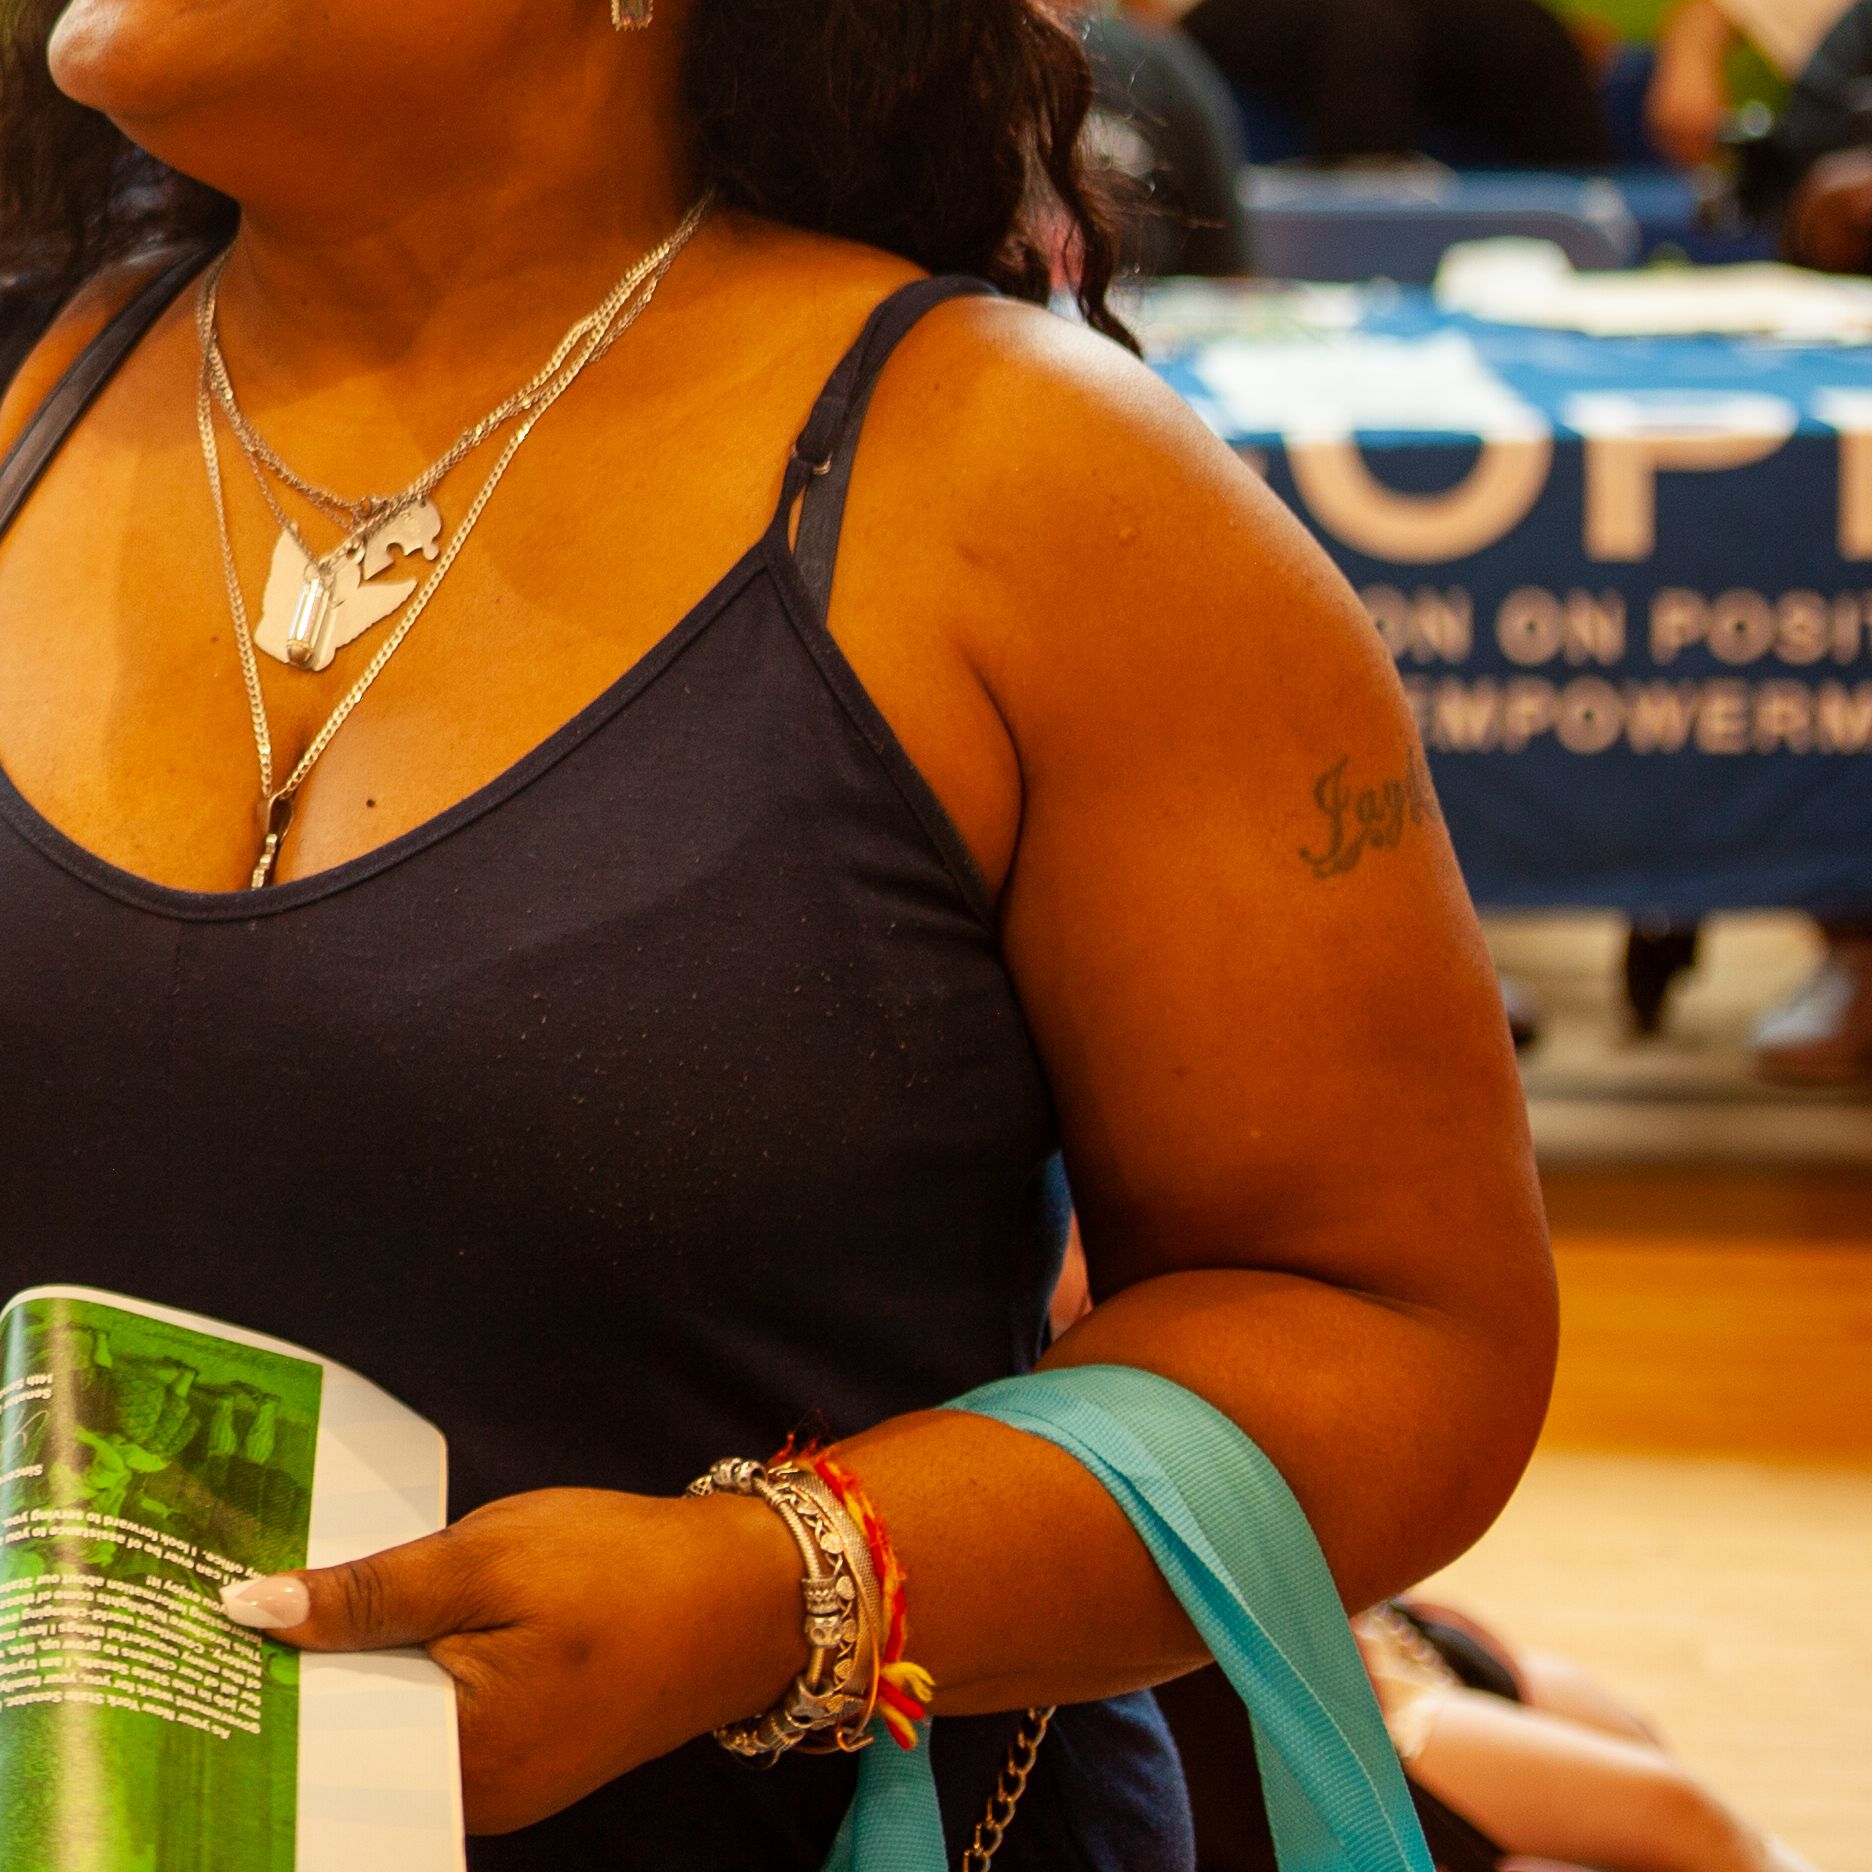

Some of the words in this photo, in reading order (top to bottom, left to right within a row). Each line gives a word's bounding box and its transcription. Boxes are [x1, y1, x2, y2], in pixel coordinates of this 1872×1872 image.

[1241, 386, 1872, 565] OP
[1494, 585, 1628, 667] ON
[1649, 587, 1872, 668] POSI
[30, 1509, 85, 1521] serving
[86, 1512, 102, 1524] to
[4, 1526, 32, 1544] you
[32, 1527, 47, 1539] to
[48, 1526, 126, 1544] assistance
[103, 1516, 159, 1542] forward
[126, 1537, 143, 1549] of
[144, 1543, 162, 1559] be
[160, 1533, 191, 1555] look
[192, 1546, 198, 1557] I
[163, 1551, 194, 1569] ever
[36, 1574, 61, 1585] our
[195, 1563, 222, 1580] can
[0, 1578, 33, 1594] State
[60, 1574, 105, 1588] about
[36, 1591, 52, 1605] of
[53, 1590, 94, 1602] some
[107, 1579, 188, 1616] information
[163, 1579, 201, 1603] enjoy
[21, 1604, 135, 1626] world-changing
[96, 1595, 167, 1625] highlights
[18, 1625, 48, 1637] love
[58, 1621, 105, 1638] things
[169, 1615, 231, 1650] brochure
[189, 1605, 262, 1648] interesting
[106, 1627, 180, 1657] wonderful
[137, 1618, 205, 1654] Countless
[62, 1639, 102, 1651] grow
[103, 1644, 119, 1657] to
[233, 1642, 261, 1663] This
[39, 1657, 64, 1668] am
[121, 1647, 177, 1670] citizens
[182, 1651, 220, 1674] many
[43, 1671, 77, 1684] your
[131, 1666, 170, 1687] State
[178, 1665, 203, 1681] our
[221, 1668, 244, 1685] the
[113, 1679, 136, 1694] for
[172, 1678, 196, 1695] the
[204, 1676, 219, 1688] of
[220, 1682, 240, 1696] all
[246, 1678, 261, 1690] of
[64, 1692, 105, 1705] State
[136, 1684, 174, 1702] work
[198, 1688, 213, 1703] in
[240, 1691, 261, 1706] for
[107, 1694, 140, 1712] York
[141, 1702, 176, 1721] New
[212, 1694, 237, 1712] job
[237, 1703, 261, 1719] my
[176, 1696, 261, 1734] government
[177, 1712, 210, 1731] your
[211, 1725, 231, 1739] As
